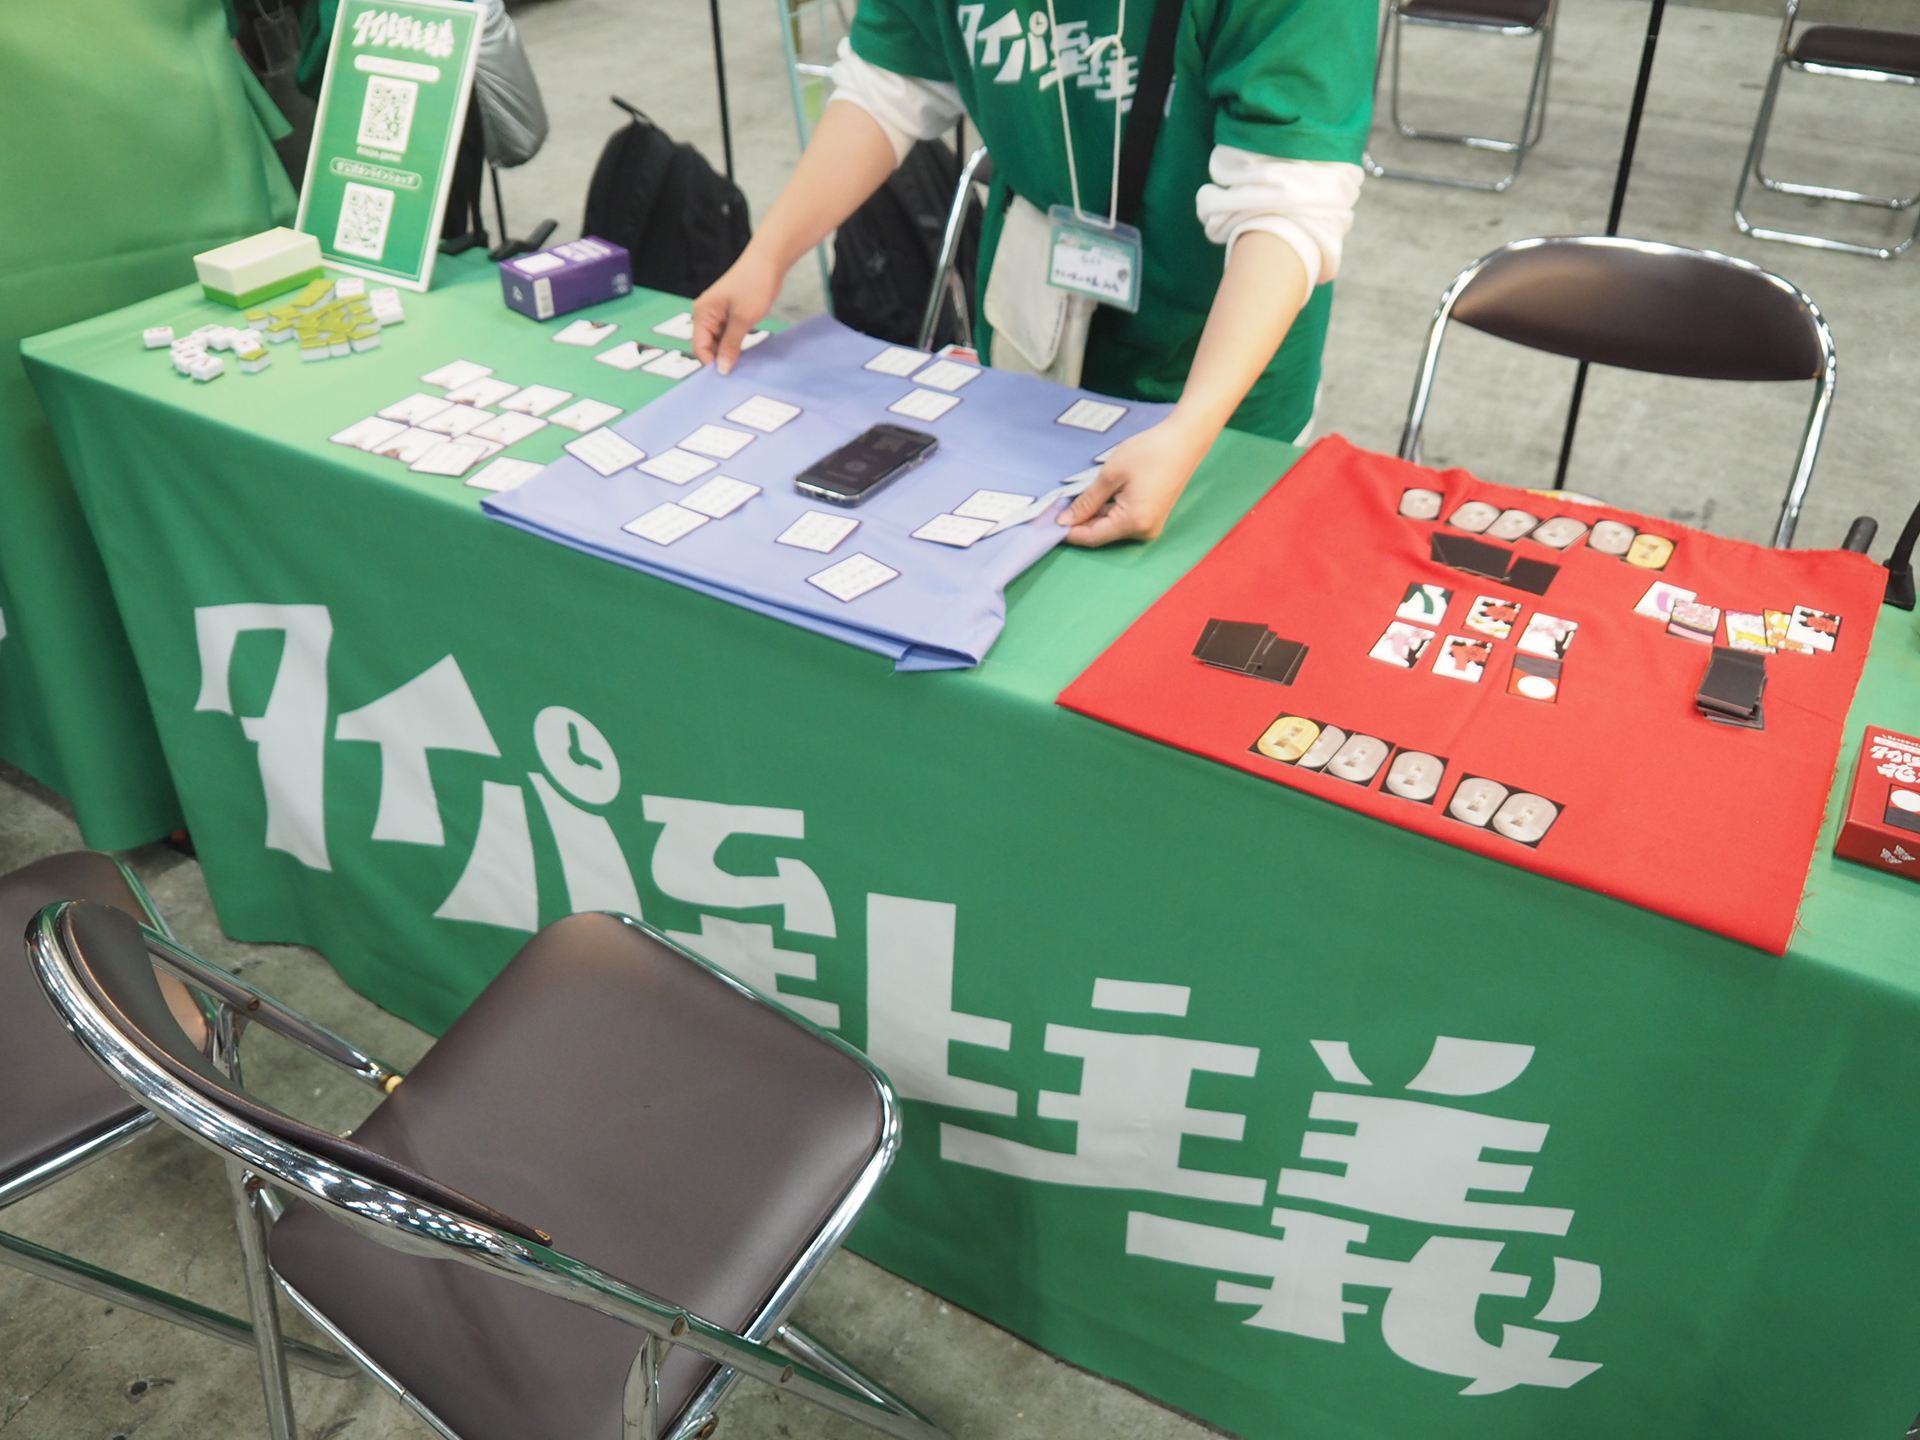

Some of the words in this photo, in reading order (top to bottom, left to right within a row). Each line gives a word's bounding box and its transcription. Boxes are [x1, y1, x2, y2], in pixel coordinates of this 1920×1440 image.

[957, 3, 1177, 117] タイパ至上主
